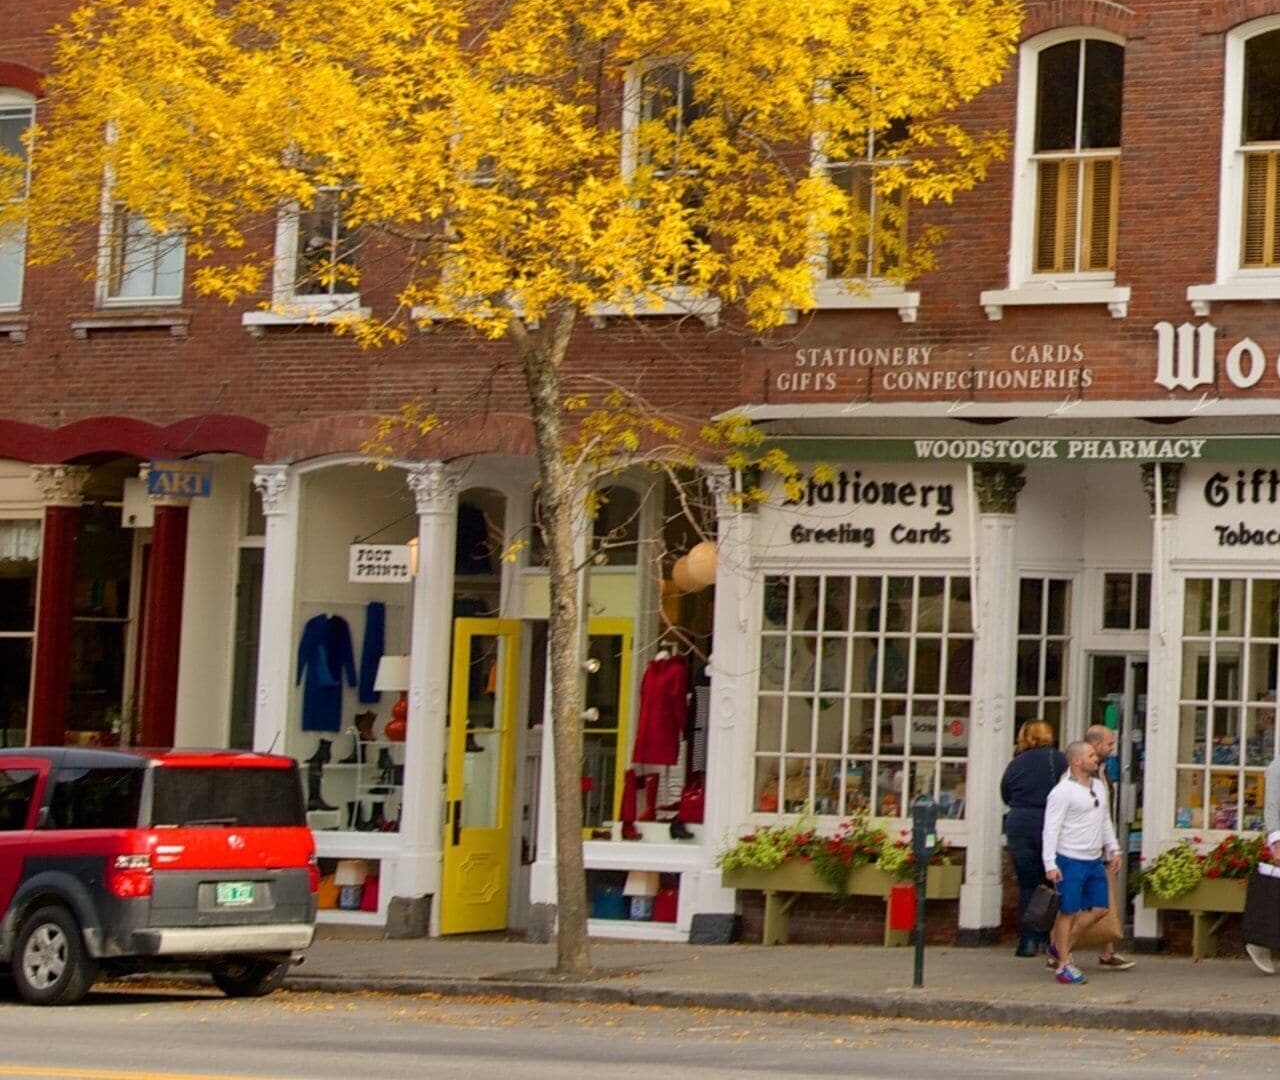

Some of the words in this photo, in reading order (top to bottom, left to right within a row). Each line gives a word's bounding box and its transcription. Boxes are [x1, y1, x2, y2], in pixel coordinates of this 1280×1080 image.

[795, 347, 933, 367] STATIONERY
[1011, 344, 1085, 363] CARDS
[776, 372, 837, 391] GIFTS
[882, 369, 1093, 390] CONFECTIONERIES
[914, 440, 1058, 459] WOODSTOCK
[1067, 439, 1206, 459] PHARMACY
[152, 473, 203, 494] ART
[1204, 469, 1280, 507] Gift
[790, 522, 875, 548] Greeting
[890, 522, 952, 545] Cards
[357, 564, 408, 576] PRINTS
